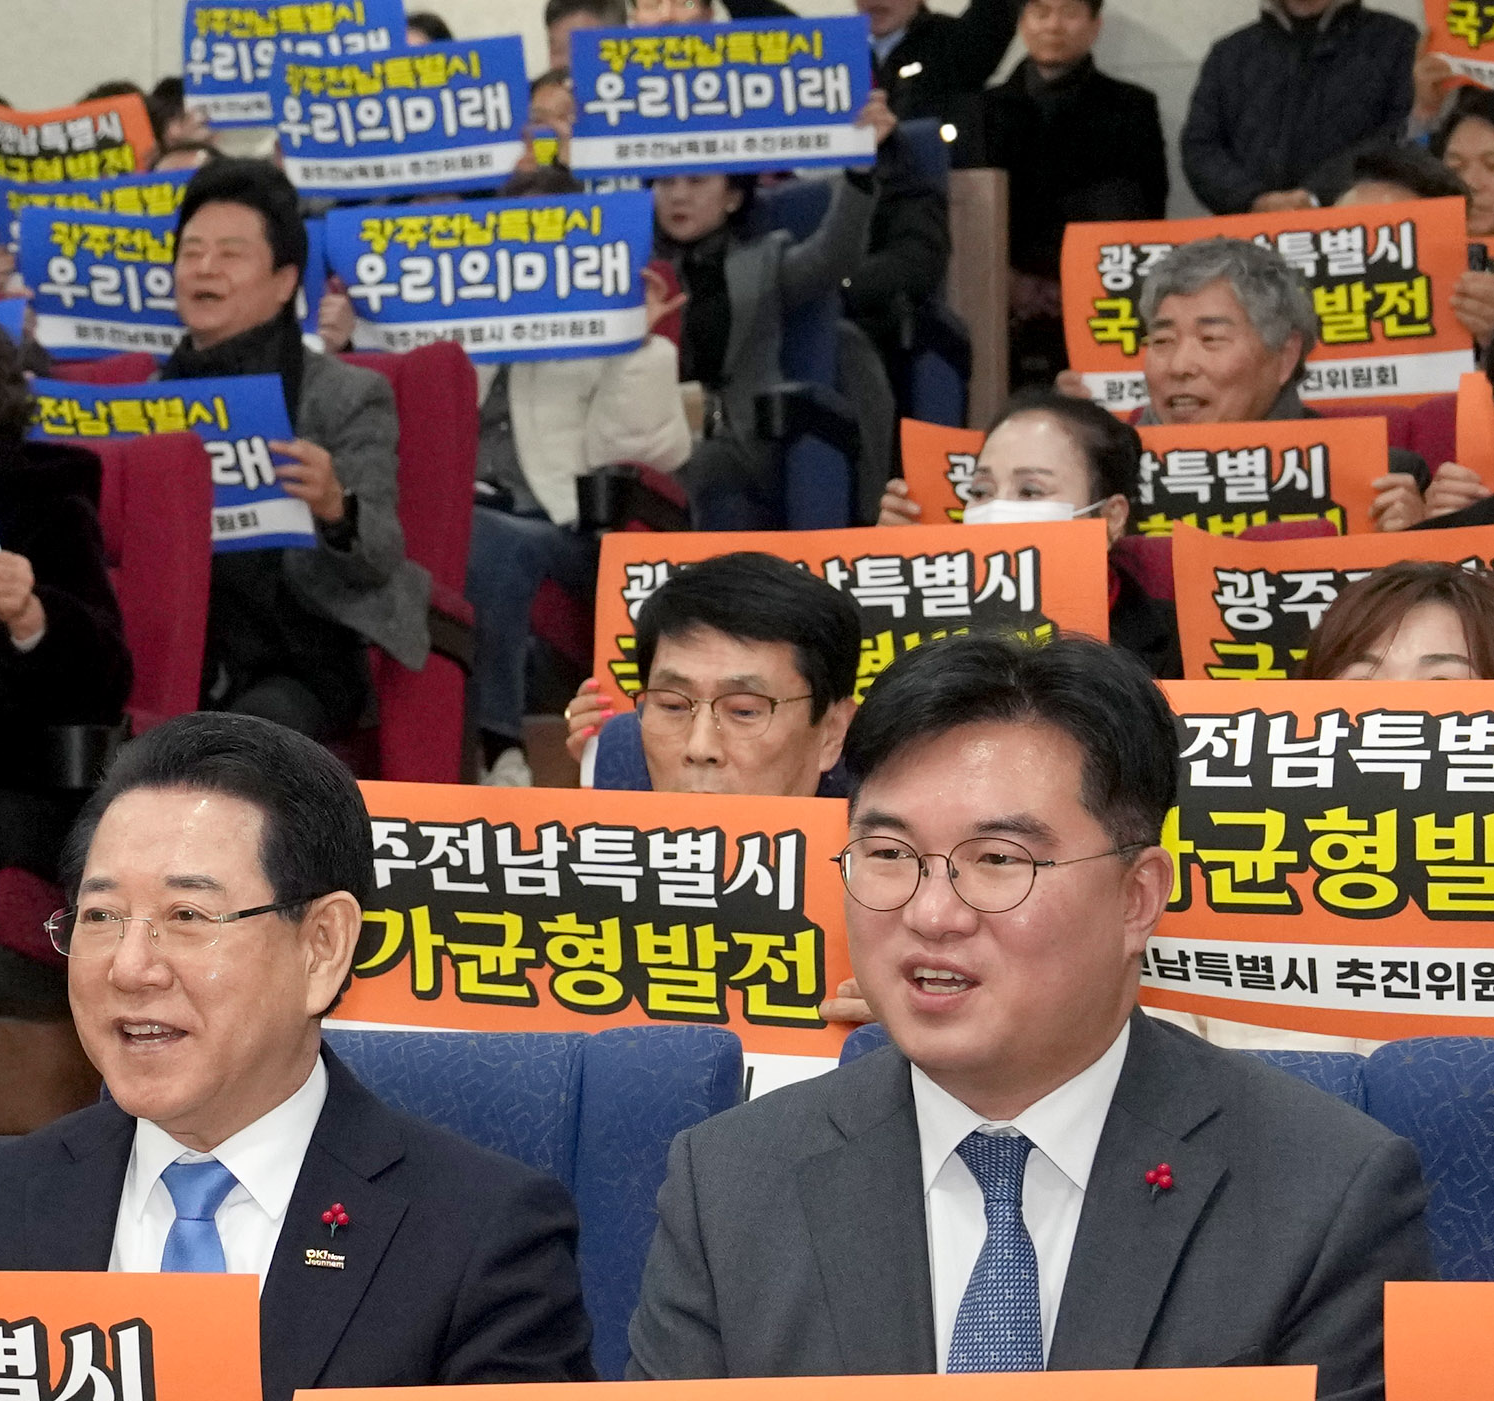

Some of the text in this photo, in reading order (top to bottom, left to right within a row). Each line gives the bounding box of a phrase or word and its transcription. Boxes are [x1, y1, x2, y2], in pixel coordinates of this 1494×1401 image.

[286, 53, 481, 97] 광주전남특별시
[601, 31, 823, 73] 광주전남특별시
[278, 82, 511, 147] 우리의미래
[584, 64, 851, 126] 우리의미래
[361, 207, 601, 255] 광주전남특별시
[348, 241, 630, 313] 우리의미래
[37, 397, 229, 436] 전남특별시
[370, 821, 797, 911] 주전남특별시
[355, 905, 821, 1021] 가균형발전
